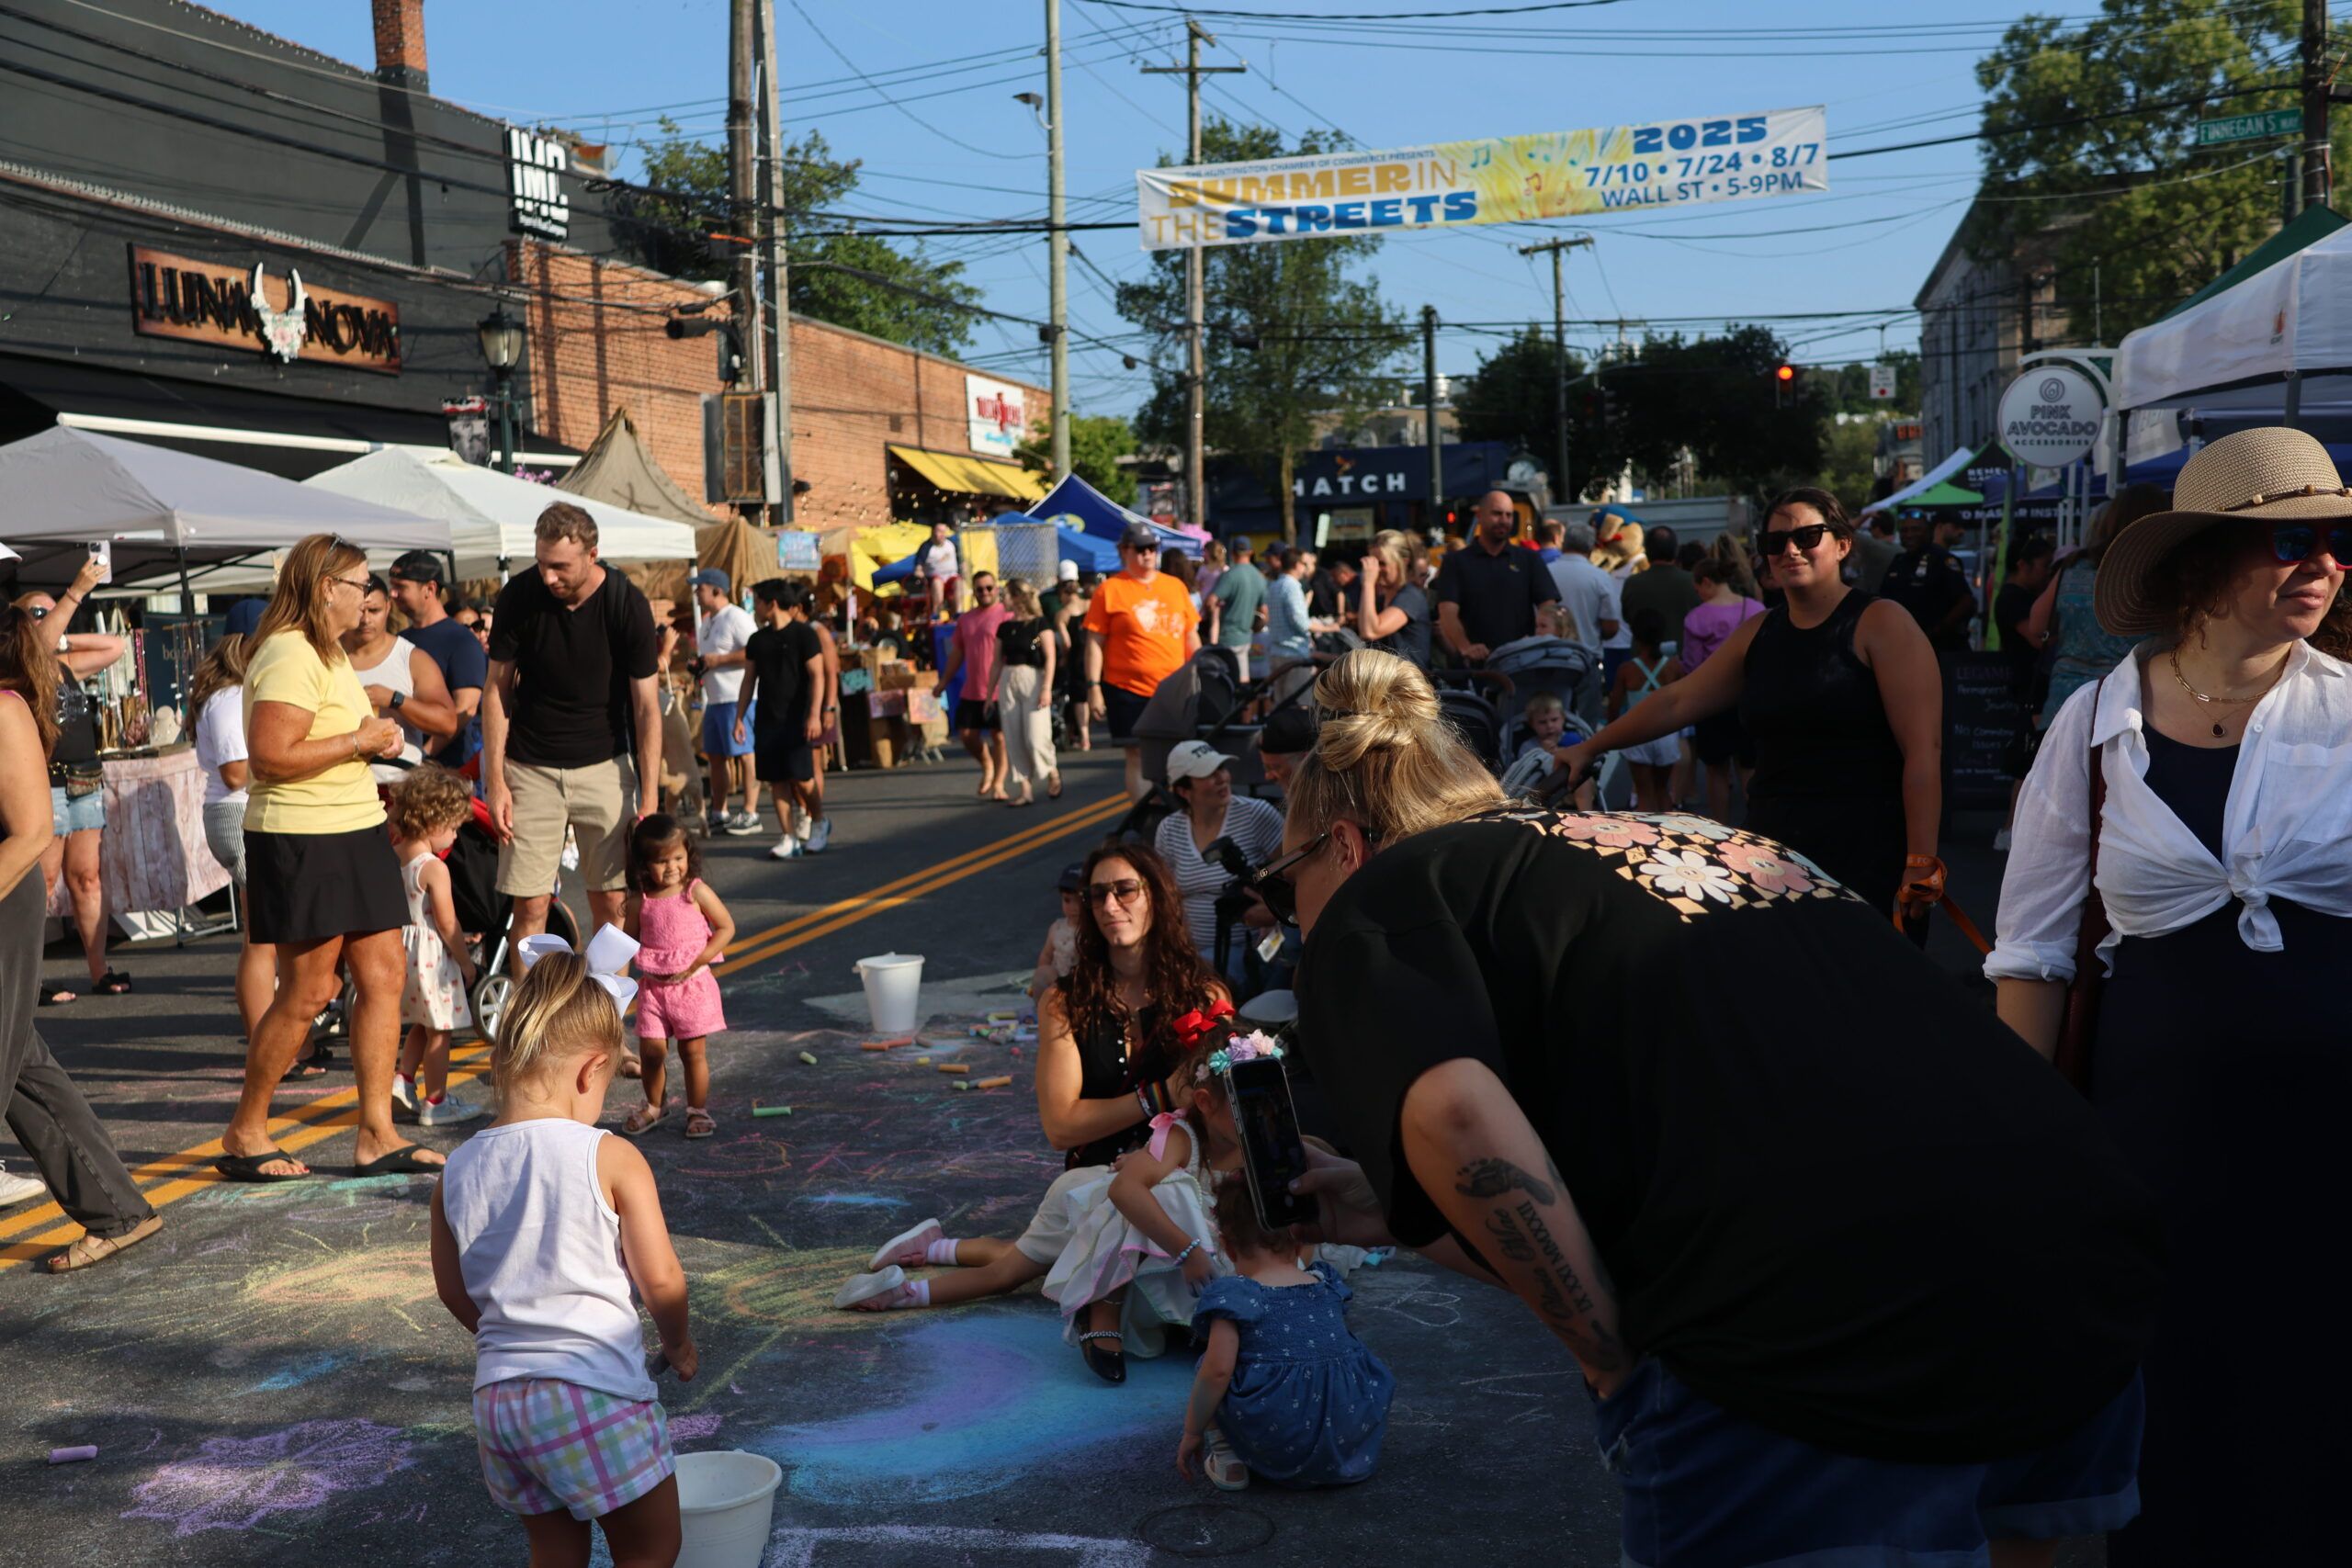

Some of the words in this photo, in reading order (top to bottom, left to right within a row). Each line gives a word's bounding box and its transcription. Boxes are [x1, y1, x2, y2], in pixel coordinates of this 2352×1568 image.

[1633, 116, 1768, 154] 2025
[1271, 158, 1316, 171] CHAMBER
[1318, 158, 1330, 168] OF
[1332, 152, 1385, 166] COMMERCE
[1388, 149, 1436, 163] PRESENTS
[1584, 163, 1649, 187] 7/10
[1678, 152, 1743, 178] 7/24
[1771, 143, 1820, 168] 8/7
[1168, 164, 1411, 209] SUMMER
[1418, 159, 1457, 190] IN
[1601, 185, 1670, 208] WALL
[1678, 181, 1704, 200] ST
[1728, 171, 1804, 196] 5-9PM
[1149, 211, 1221, 243] THE
[1226, 191, 1478, 239] STREETS
[139, 262, 257, 338] LUNA
[303, 295, 399, 362] NOVA
[2007, 421, 2098, 436] AVOCADO
[2030, 405, 2072, 420] PINK
[2014, 438, 2090, 446] ACCESSORIES
[1291, 471, 1407, 497] HATCH
